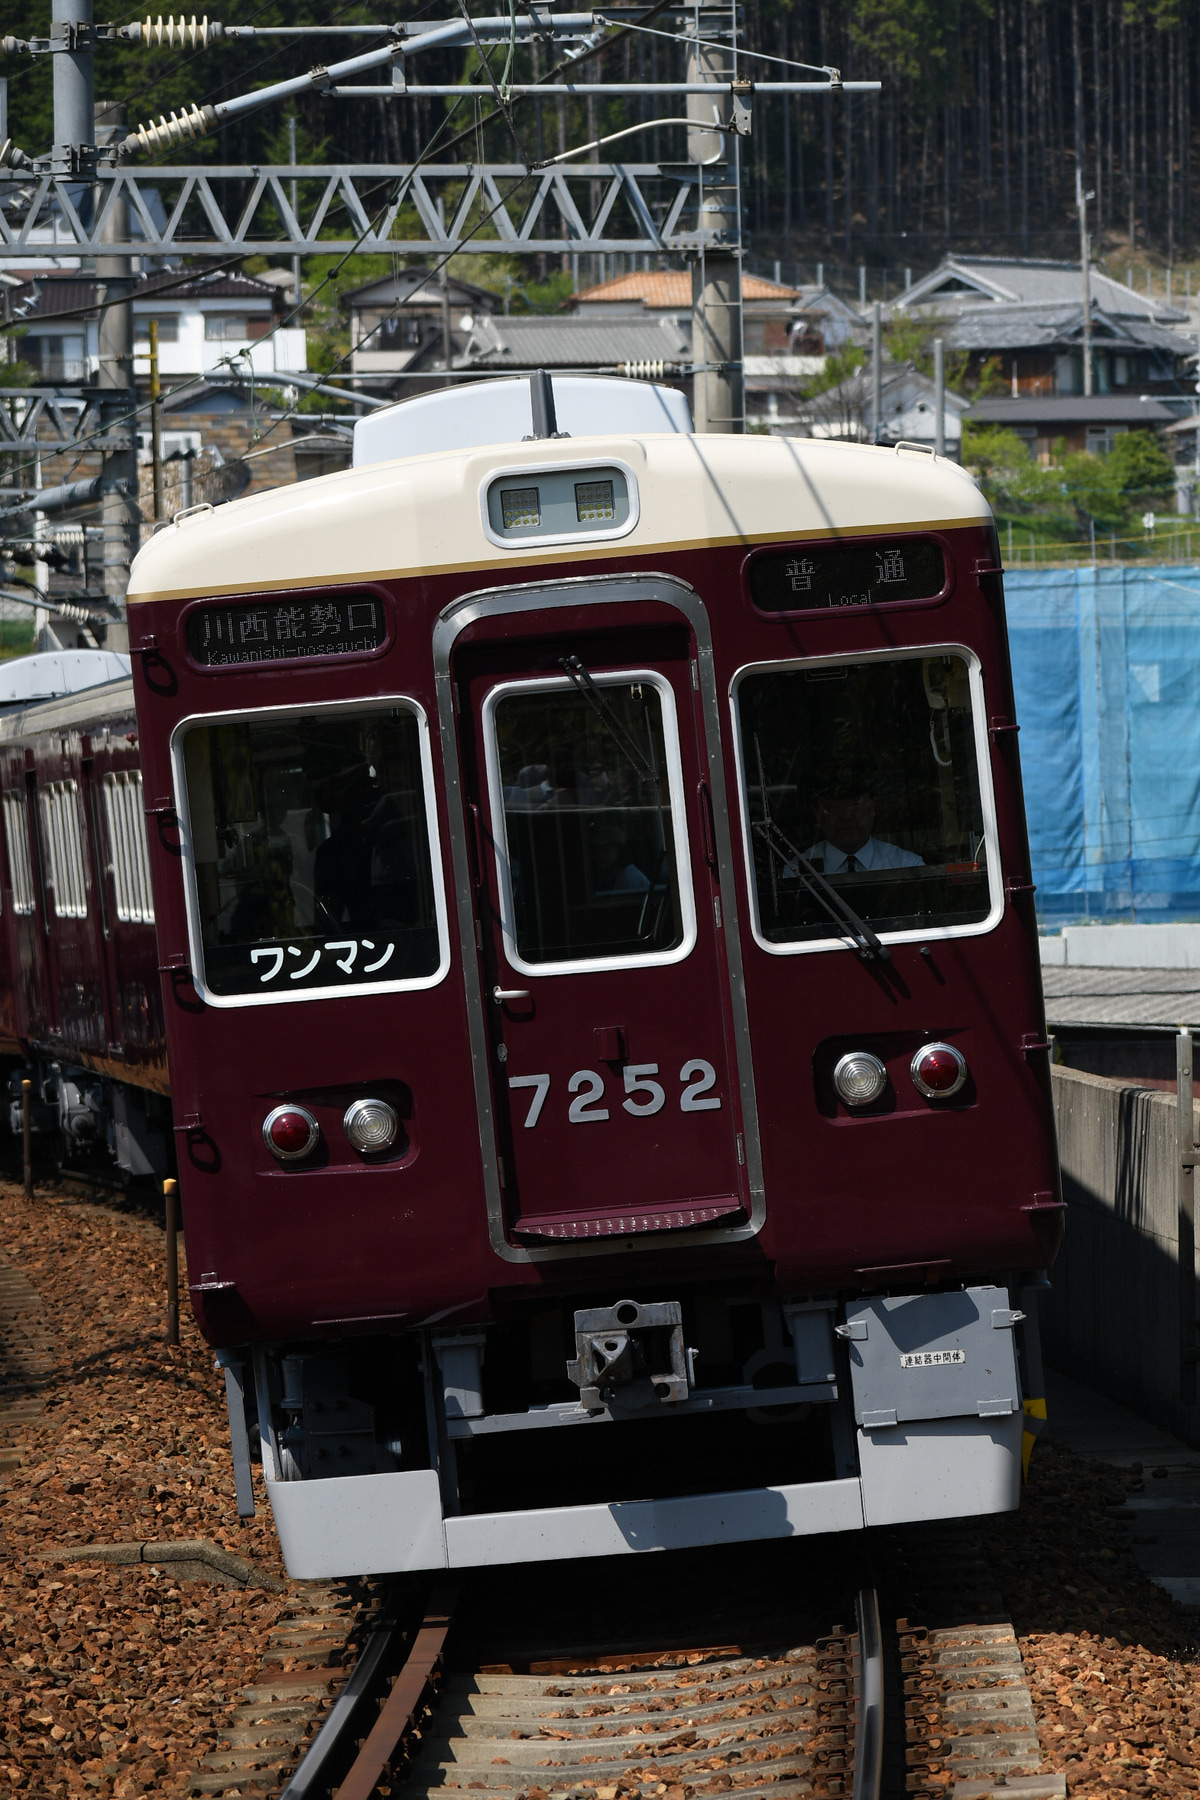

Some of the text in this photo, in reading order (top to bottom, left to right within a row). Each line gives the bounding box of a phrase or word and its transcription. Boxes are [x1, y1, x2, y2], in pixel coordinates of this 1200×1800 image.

[786, 549, 907, 591] 普通
[828, 589, 872, 608] Local
[203, 603, 377, 647] 川西能勢口
[250, 939, 395, 982] ワンマン
[508, 1058, 722, 1128] 7252
